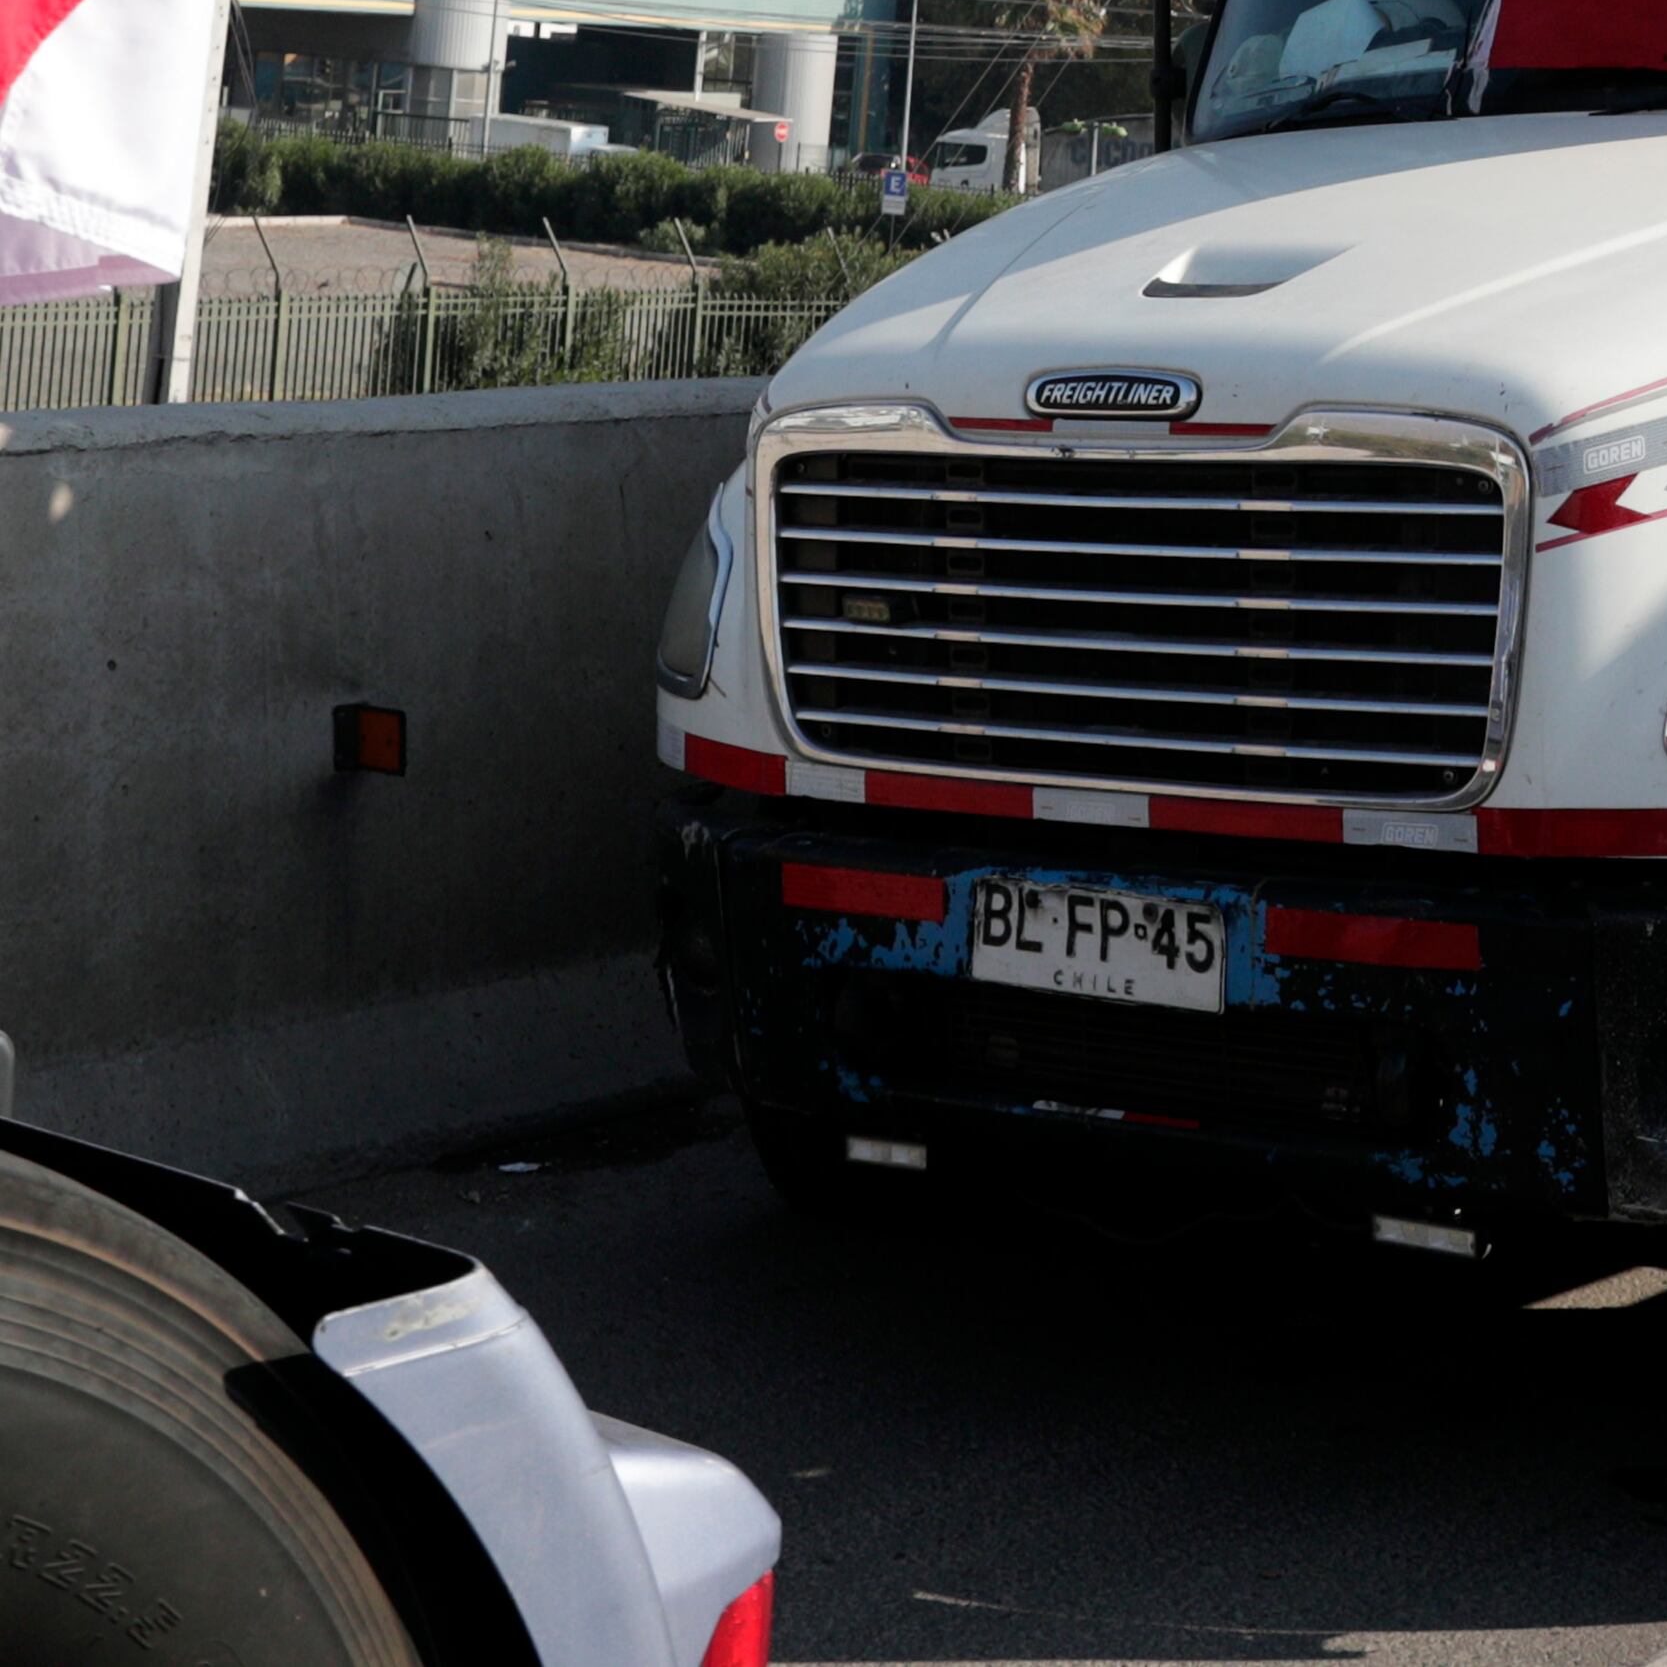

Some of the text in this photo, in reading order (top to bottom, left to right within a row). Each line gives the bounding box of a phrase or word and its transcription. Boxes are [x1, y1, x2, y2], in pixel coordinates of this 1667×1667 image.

[889, 175, 902, 193] E
[1040, 381, 1176, 406] FREIGHTLINER
[1586, 440, 1643, 470] GOREN
[1385, 825, 1436, 846] GOREN
[1052, 969, 1135, 996] CHILE
